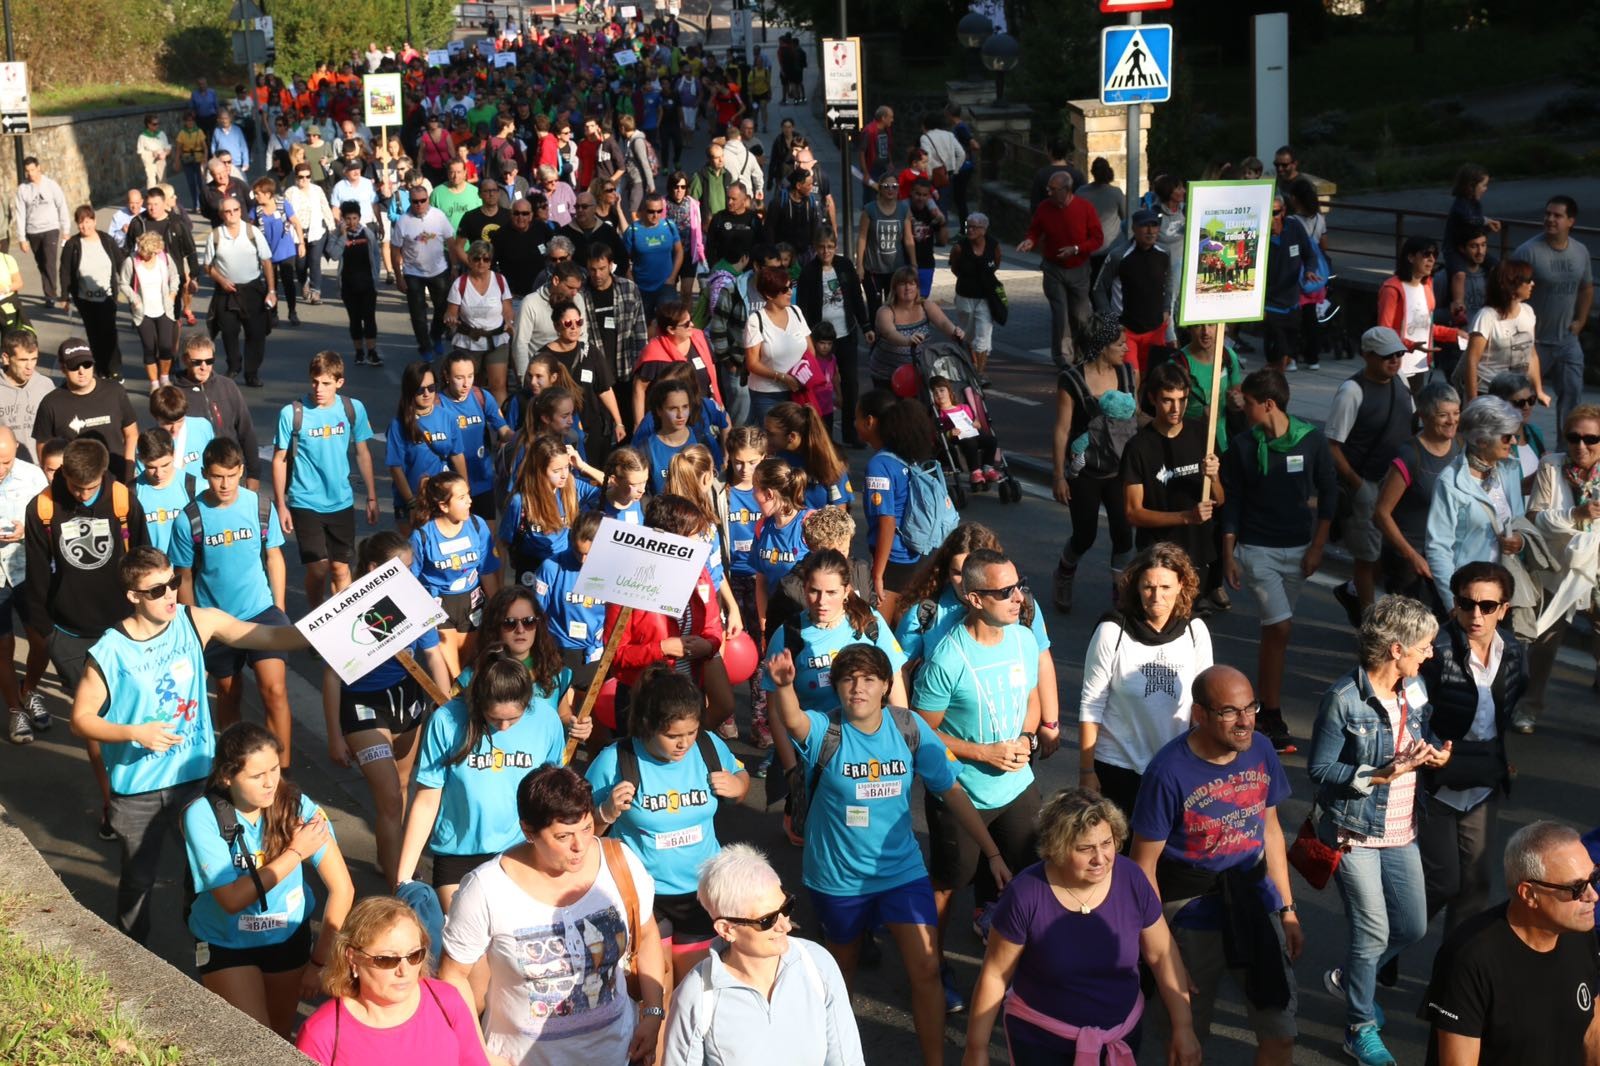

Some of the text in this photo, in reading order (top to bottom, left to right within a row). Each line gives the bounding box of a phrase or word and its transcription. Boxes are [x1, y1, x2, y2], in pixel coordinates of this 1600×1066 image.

[205, 528, 253, 546] ERRONKA
[613, 530, 694, 559] UDARREGI
[434, 552, 478, 570] ERRONKA
[616, 575, 662, 597] Udarregi
[308, 566, 400, 632] AITA LARRAMENDI
[468, 749, 532, 771] ERRONKA
[843, 759, 906, 781] ERRONKA
[642, 788, 707, 812] ERRONKA
[870, 787, 891, 797] BAI!
[1183, 778, 1224, 812] RINIDAD
[1228, 774, 1236, 784] &
[1189, 818, 1221, 832] ATLANTIC
[671, 834, 691, 846] BAI!
[253, 919, 275, 931] BAI!
